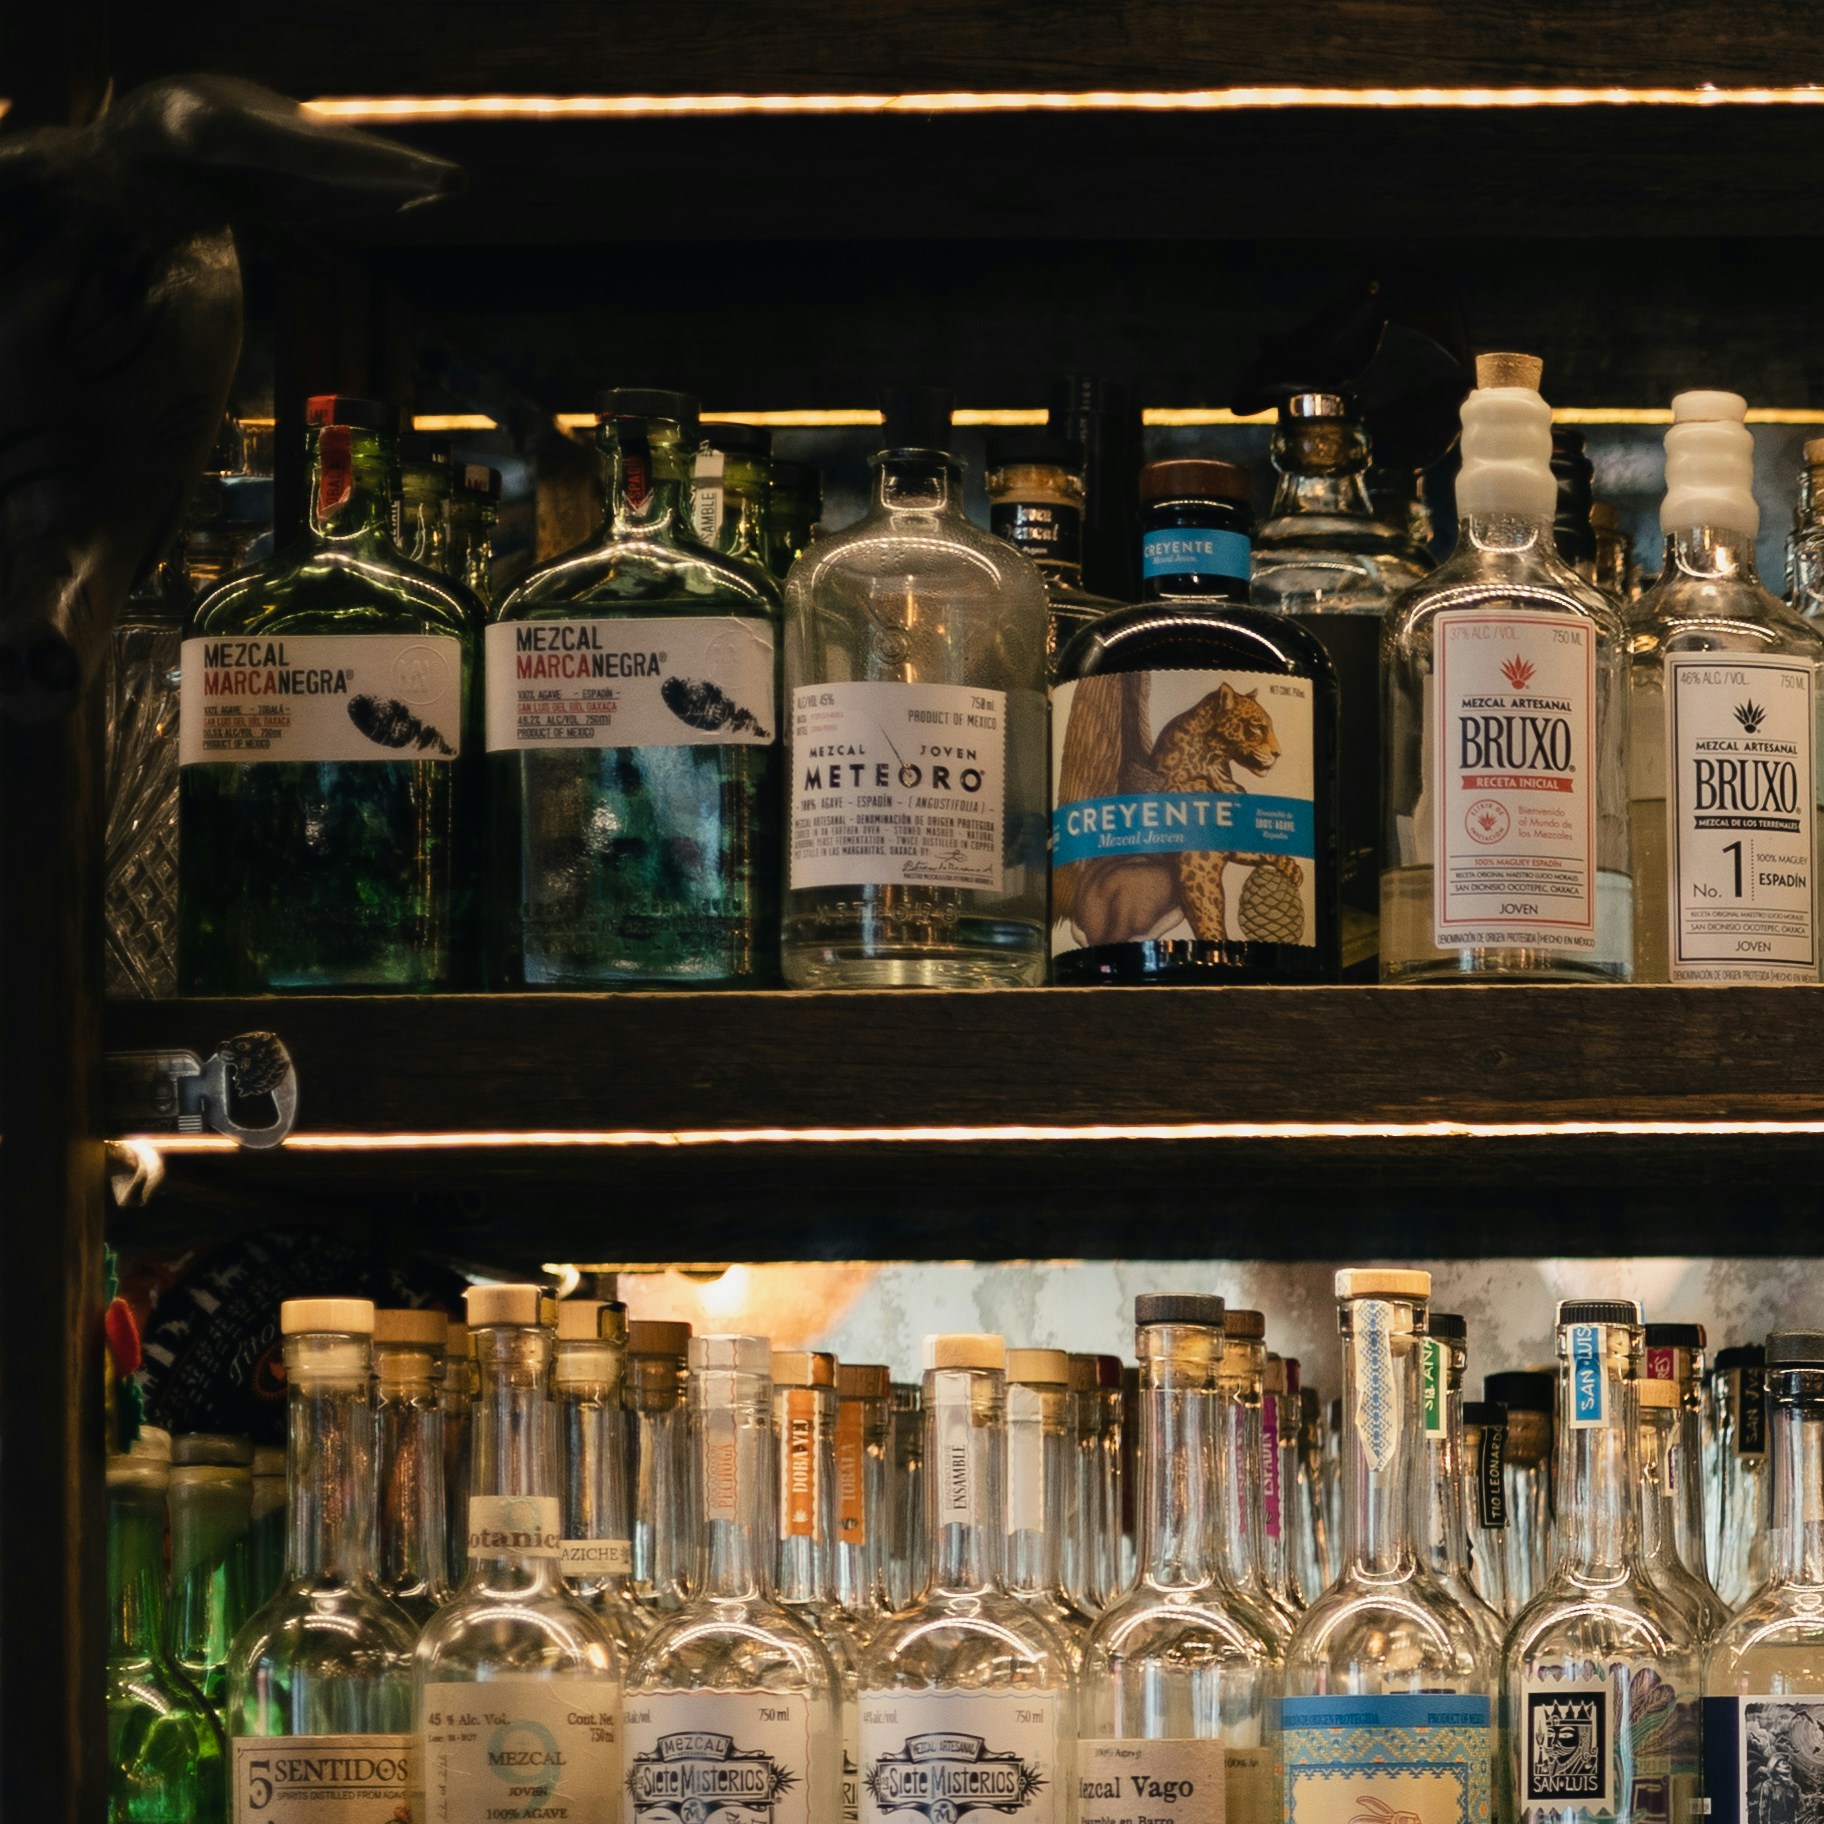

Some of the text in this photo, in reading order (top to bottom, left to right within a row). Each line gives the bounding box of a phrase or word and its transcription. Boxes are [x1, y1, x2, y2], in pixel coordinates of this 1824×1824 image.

[1144, 540, 1213, 558] CREYENTE
[517, 627, 603, 651] MEZCAL
[205, 643, 289, 668] MEZCAL
[517, 653, 660, 679] MARCANEGRA
[205, 670, 347, 695] MARCANEGRA
[1462, 698, 1572, 711] MEZCAL ARTESANAL
[908, 710, 997, 729] PRODUCT OF MEXICO
[810, 744, 977, 760] MEZCAL JOVEN
[1459, 717, 1572, 771] BRUXO
[804, 763, 982, 792] METEORO
[1476, 776, 1558, 790] RECETA INICIAL
[1694, 759, 1797, 813] BRUXO
[1067, 801, 1234, 836] CREYENTE
[1098, 829, 1184, 848] Mezcal Joven
[1722, 840, 1742, 898] 1
[1759, 872, 1806, 888] ESPADÍN
[1694, 883, 1722, 899] No.
[1499, 903, 1538, 915] JOVEN
[489, 1752, 565, 1766] MEZCAL
[249, 1757, 408, 1809] 5 SENTIDOS
[1131, 1776, 1194, 1803] Vago
[487, 1808, 567, 1819] 100% AGAVE
